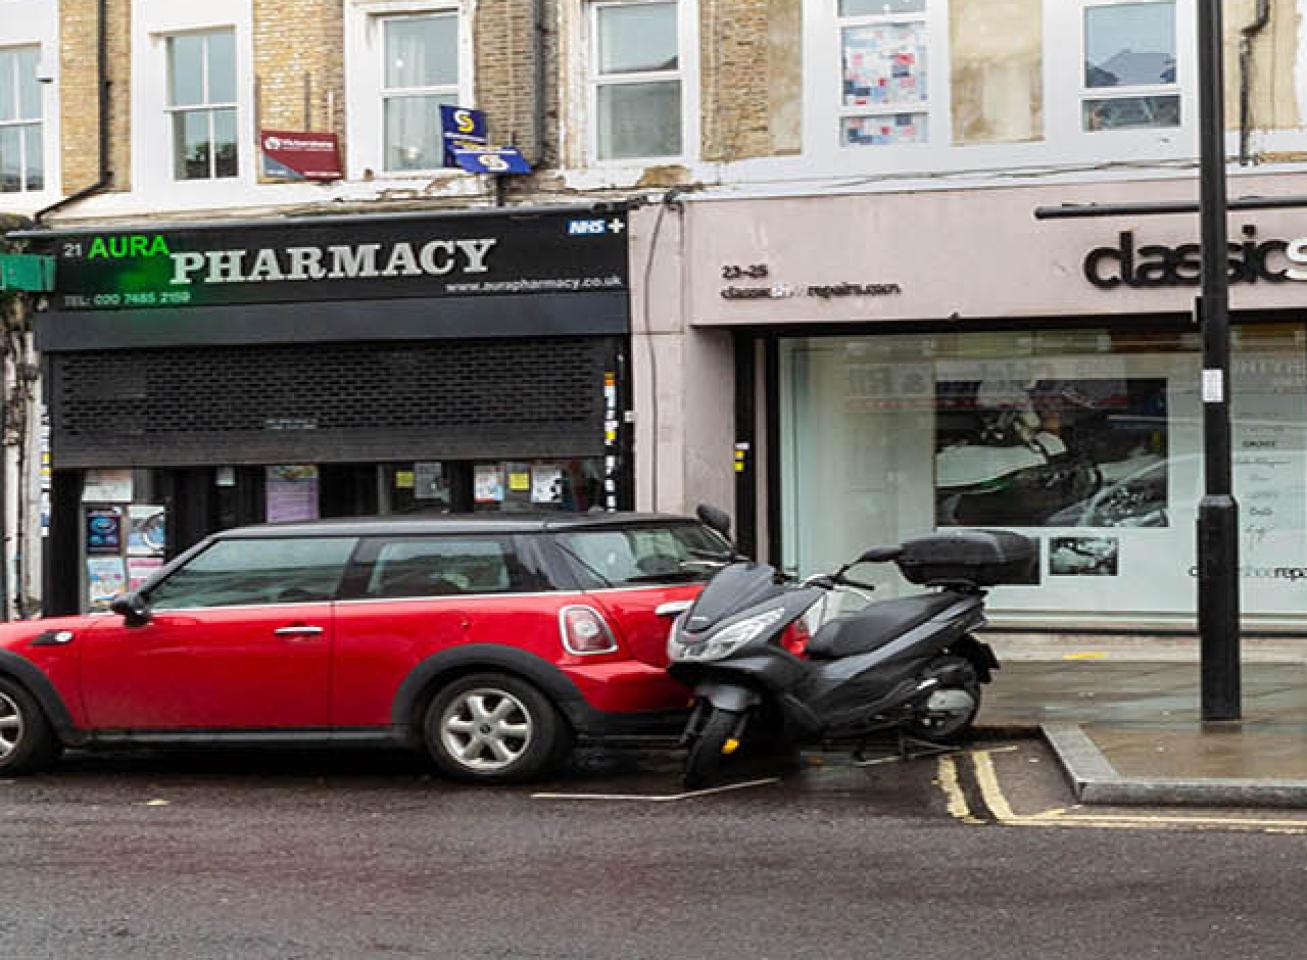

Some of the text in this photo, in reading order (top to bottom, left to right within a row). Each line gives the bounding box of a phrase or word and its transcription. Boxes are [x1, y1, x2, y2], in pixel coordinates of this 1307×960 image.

[568, 219, 604, 234] NHS
[63, 234, 169, 259] 21 AURA
[168, 238, 497, 286] PHARMACY
[722, 265, 768, 278] 23-25
[445, 275, 622, 292] www.aurapharmacy.co.uk
